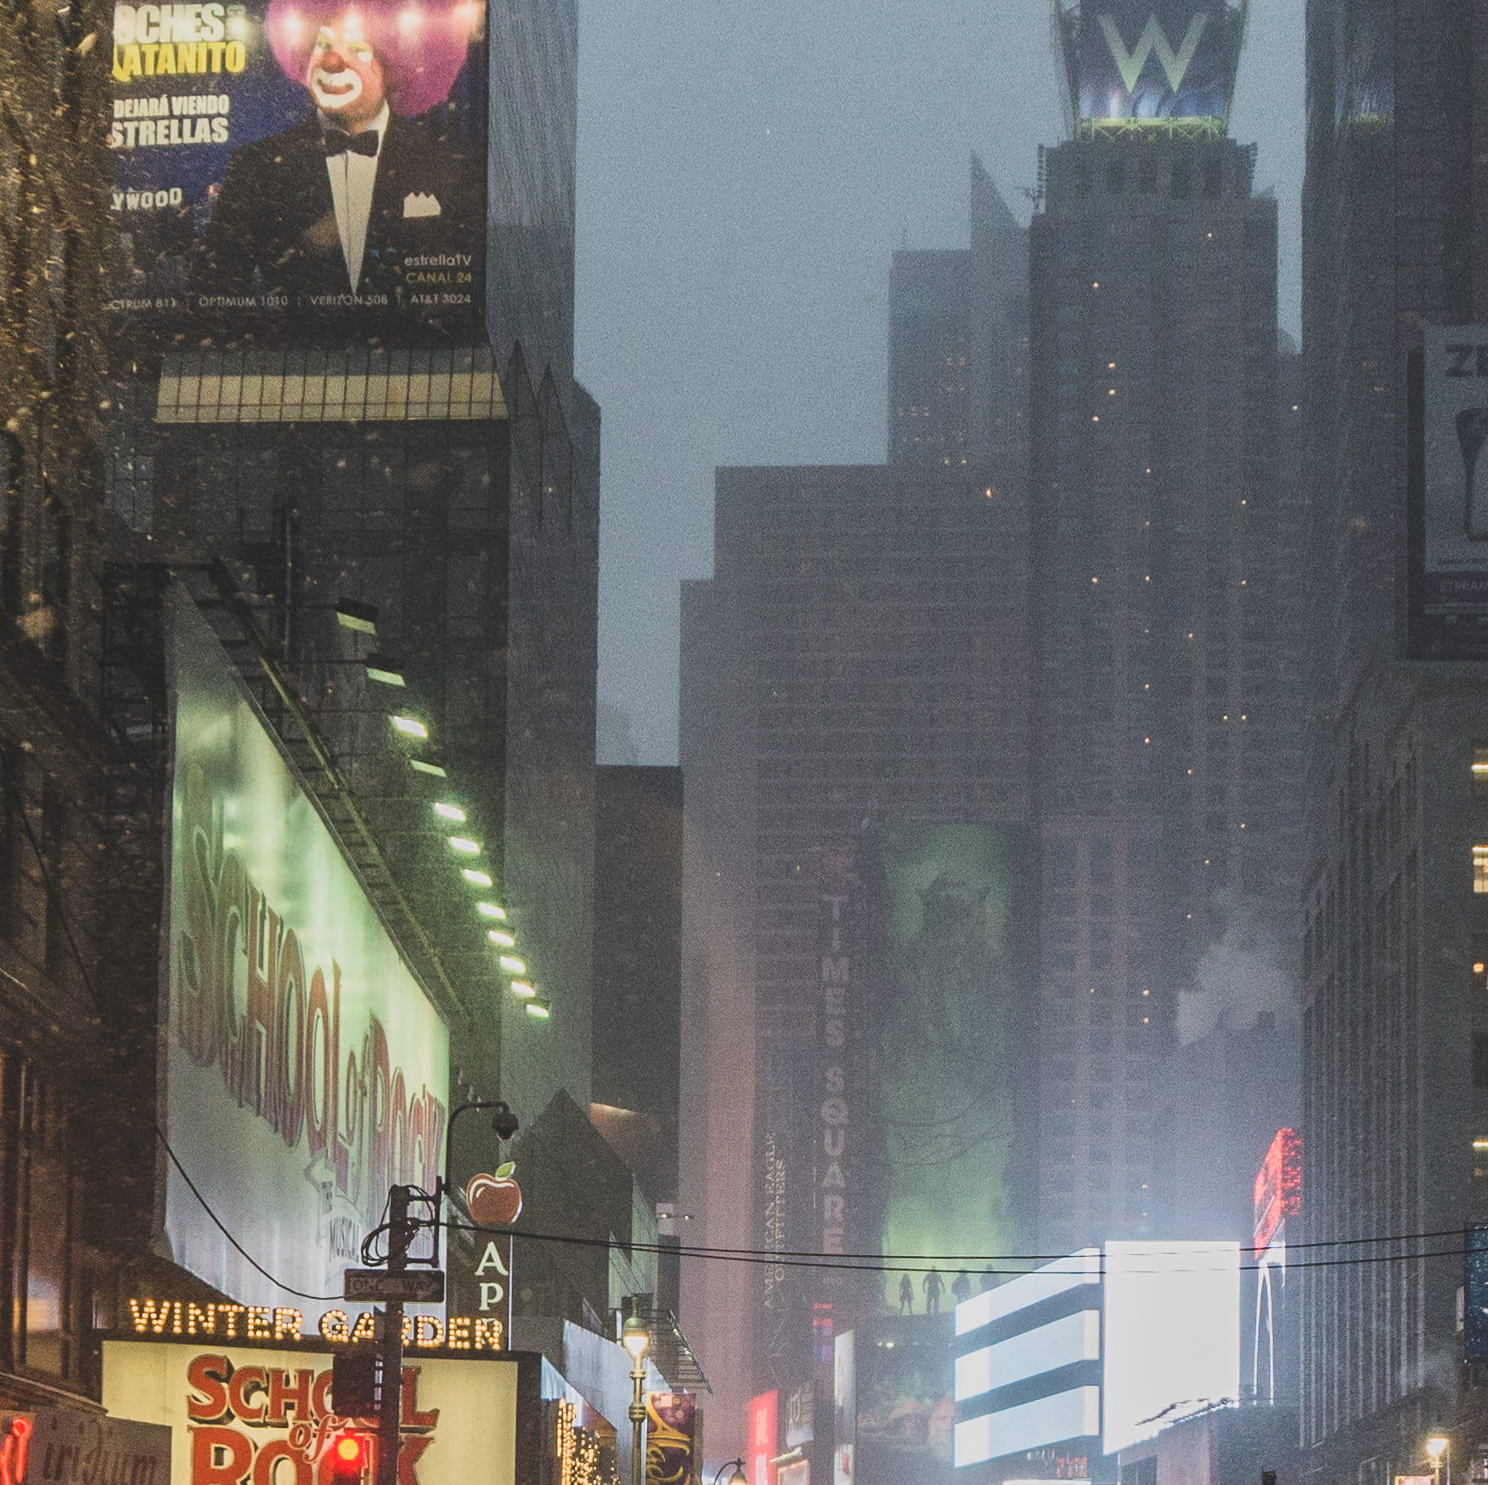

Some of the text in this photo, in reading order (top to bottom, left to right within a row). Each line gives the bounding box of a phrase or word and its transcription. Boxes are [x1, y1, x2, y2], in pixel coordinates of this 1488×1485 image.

[1097, 13, 1208, 93] W
[114, 94, 230, 118] DEJARÁ VIENDO
[403, 253, 473, 268] estrellaTV
[405, 272, 473, 284] CANAL 24
[198, 296, 257, 308] OPTIMUM
[410, 294, 439, 305] AT&T
[442, 294, 472, 305] 3024
[178, 765, 343, 1170] SCHOOL
[402, 1280, 433, 1296] WAY
[130, 1298, 302, 1341] WINTER
[186, 1354, 440, 1429] SCHOL
[288, 1414, 352, 1463] of
